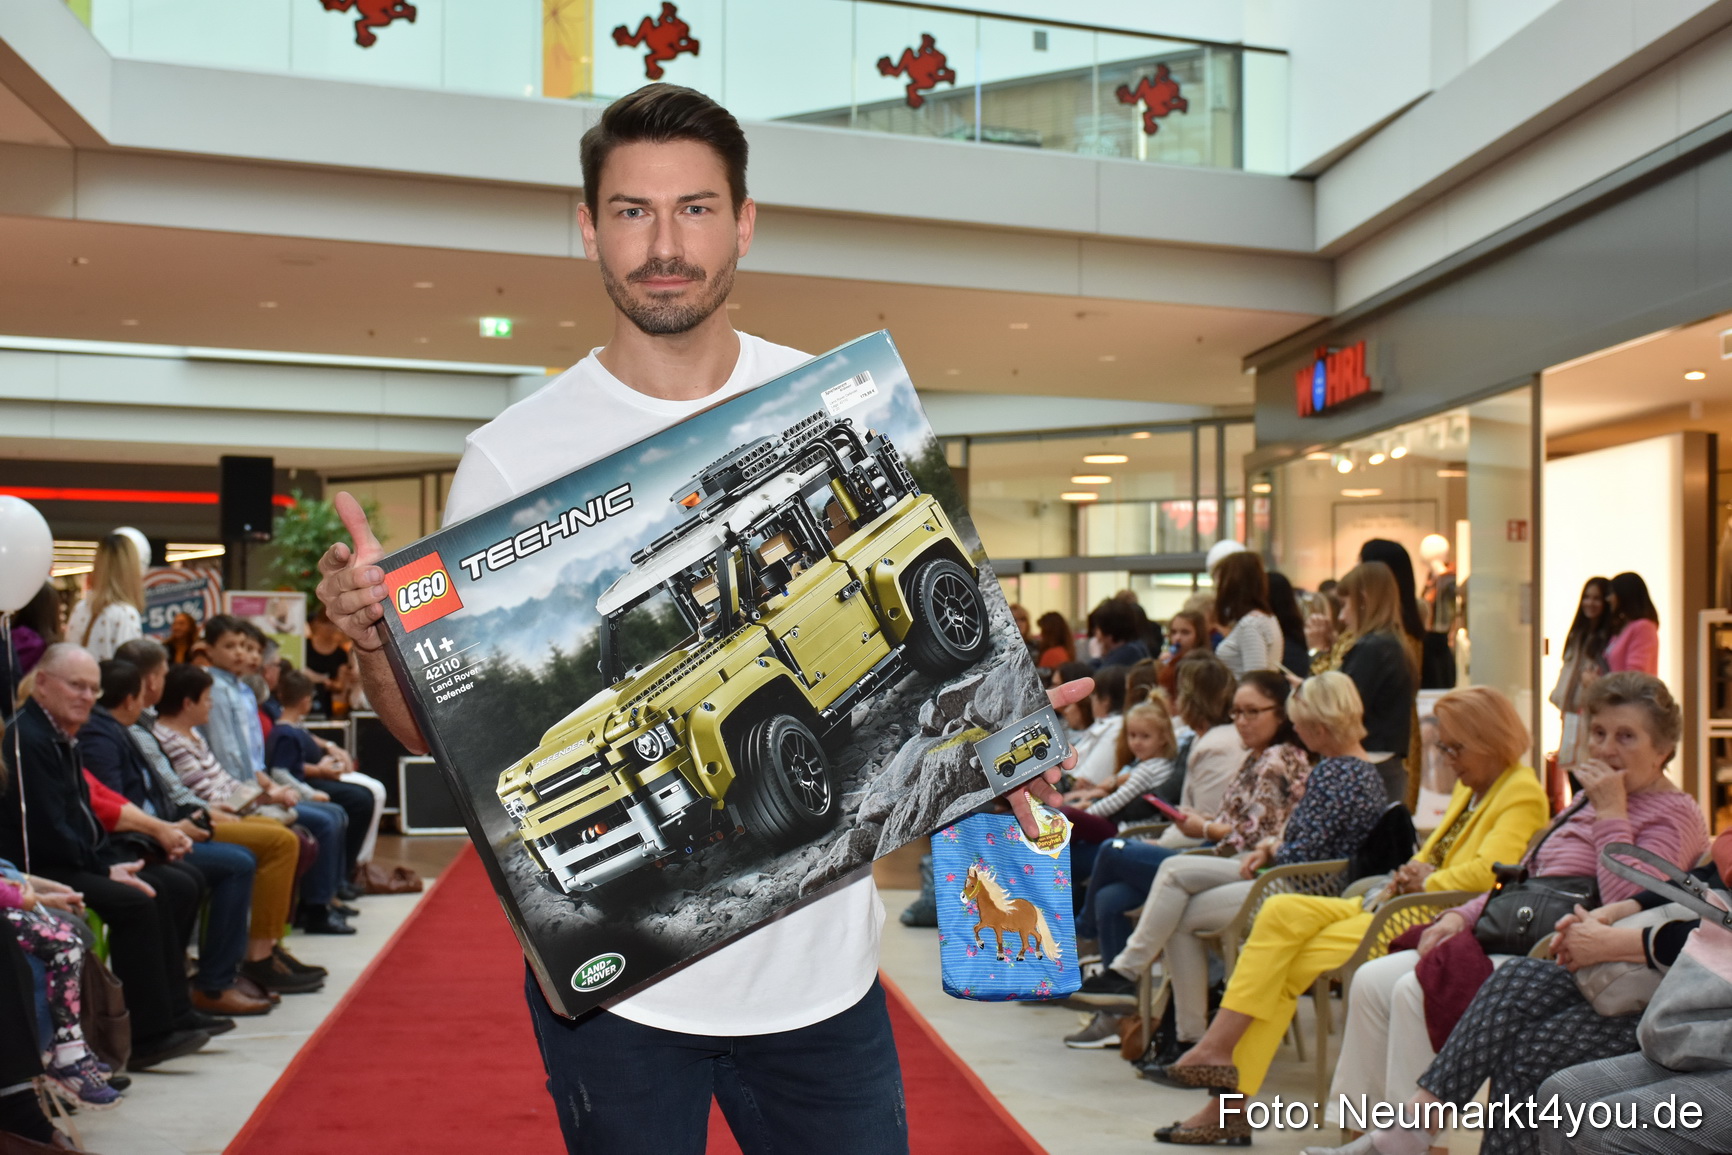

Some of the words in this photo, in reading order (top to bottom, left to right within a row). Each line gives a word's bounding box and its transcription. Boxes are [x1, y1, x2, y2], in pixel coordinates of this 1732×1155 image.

[1296, 340, 1370, 418] WÖHRL
[460, 483, 632, 580] TECHNIC
[398, 570, 448, 614] LEGO
[414, 636, 454, 664] 11+
[425, 657, 461, 682] 42110
[431, 677, 454, 693] Land
[453, 666, 480, 683] Rover
[436, 681, 475, 703] Defender
[534, 739, 585, 770] DEFENDER
[581, 960, 606, 979] LAND
[587, 964, 617, 986] ROVER
